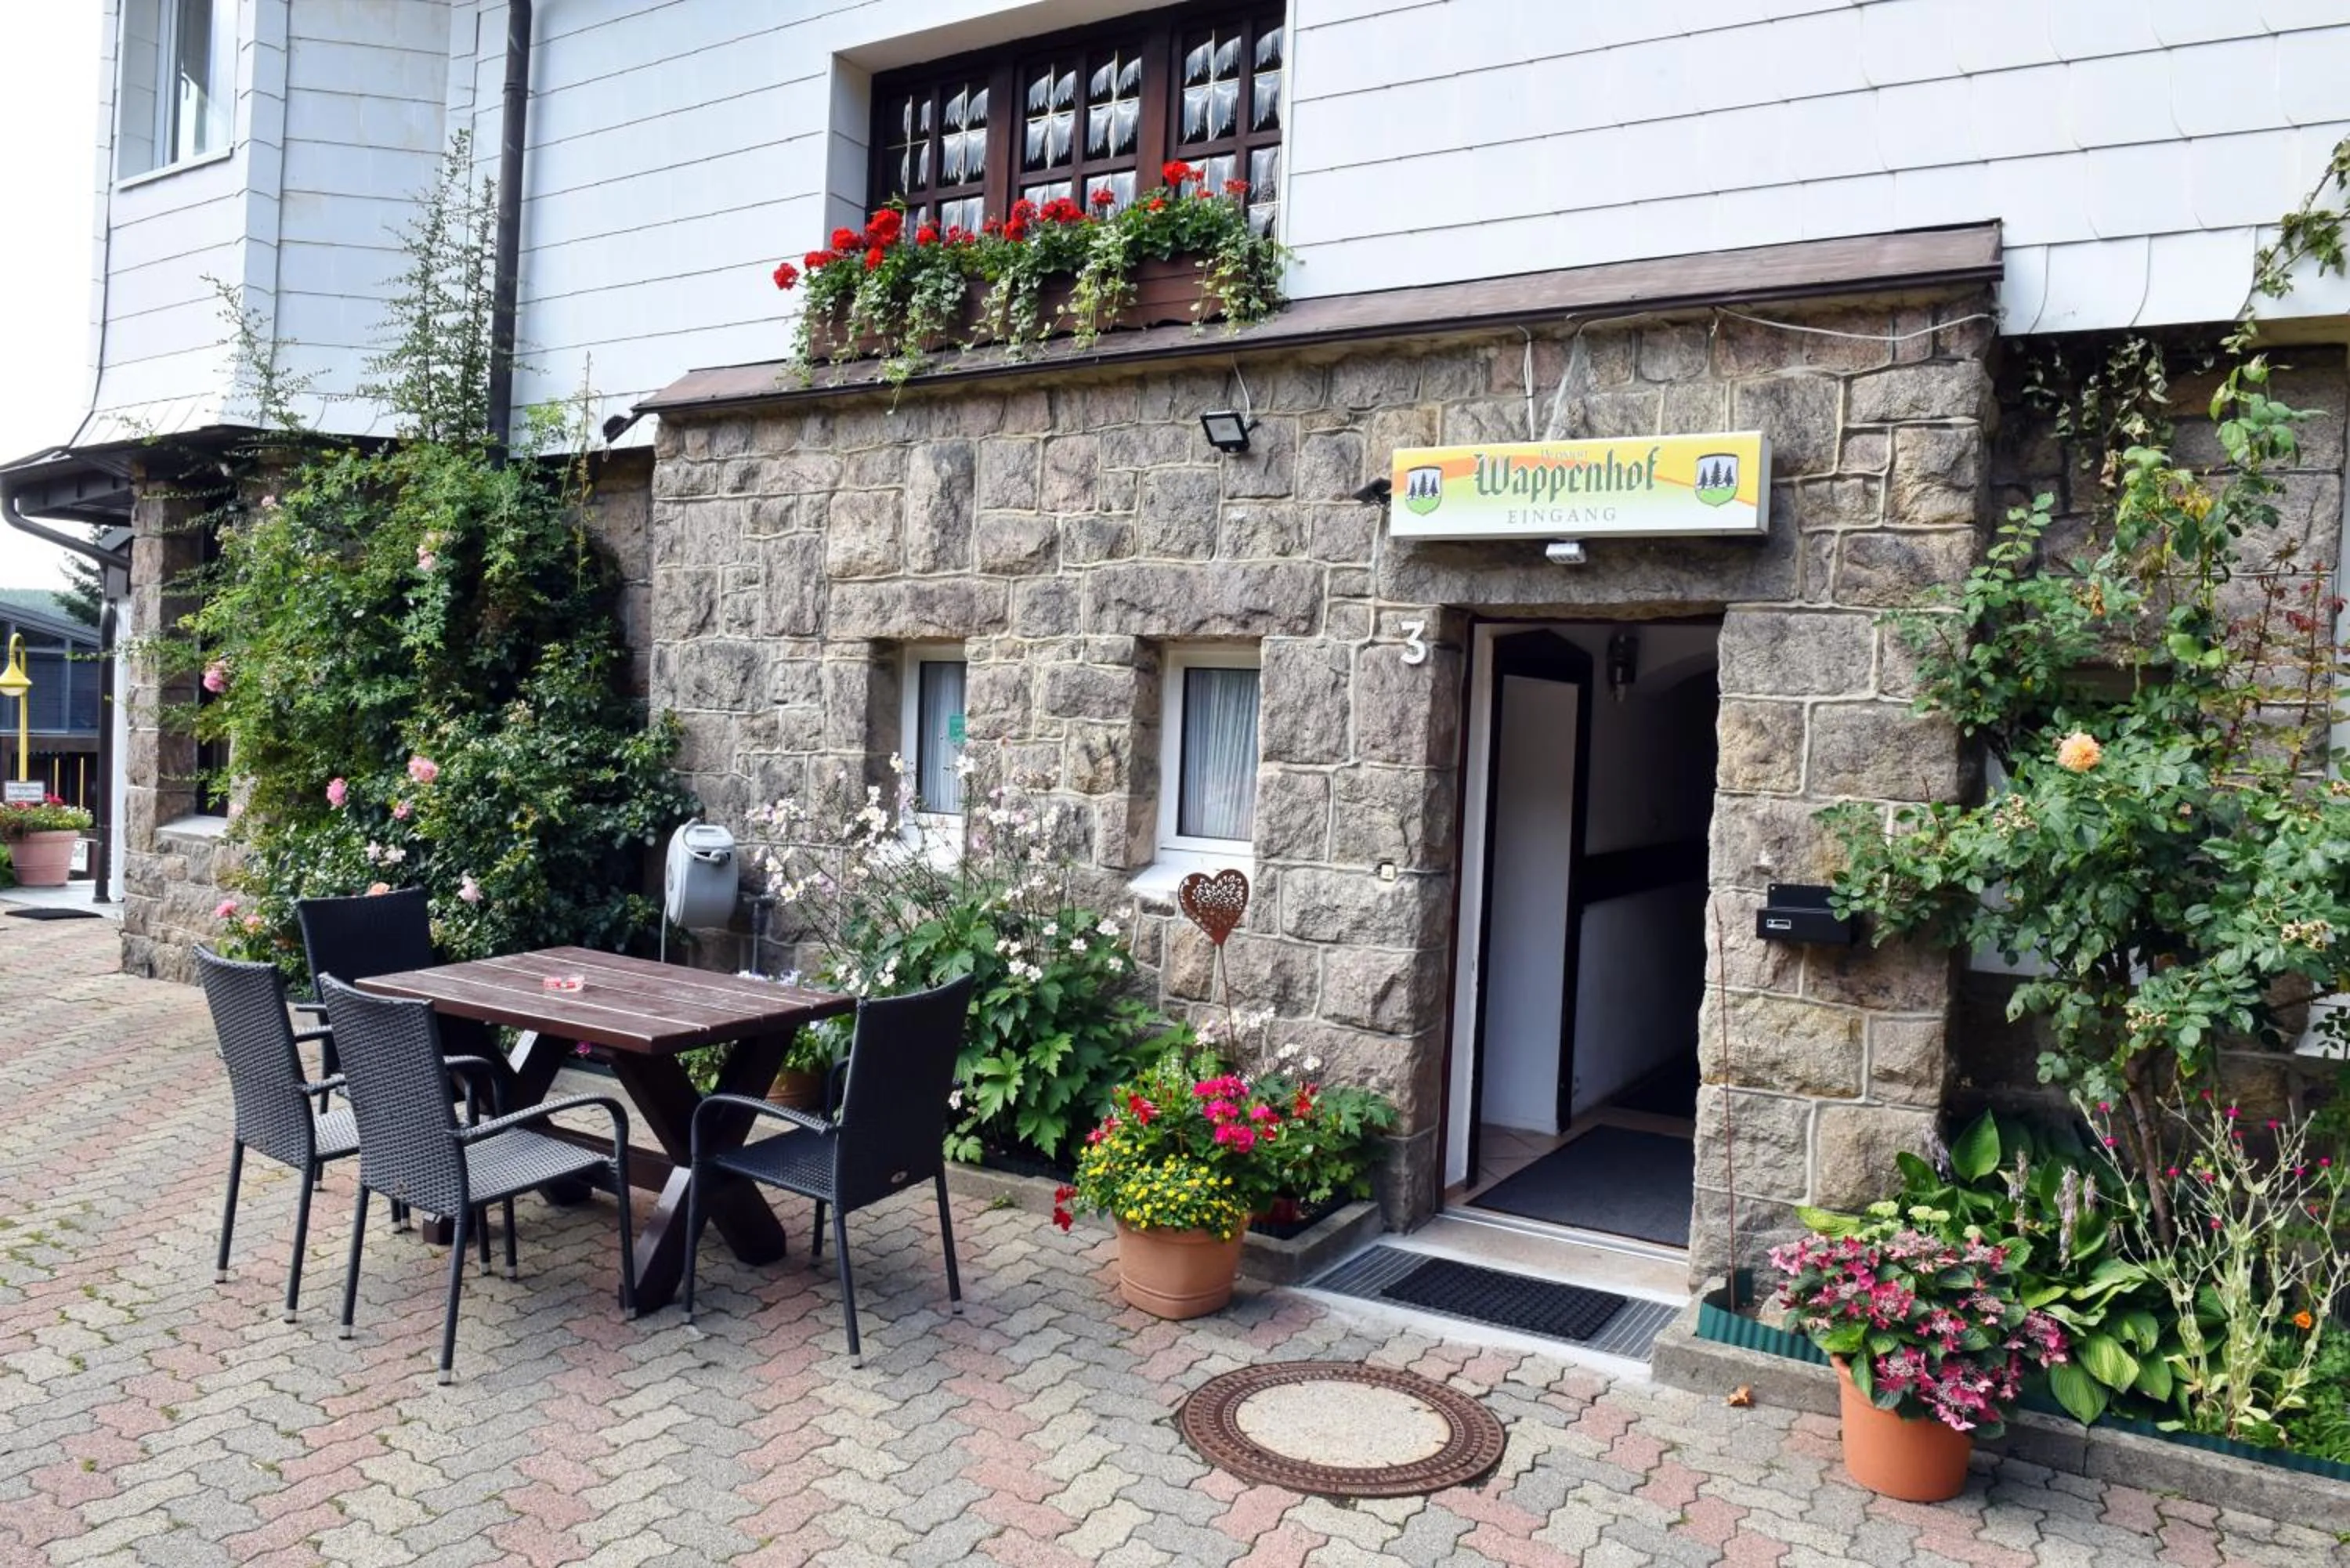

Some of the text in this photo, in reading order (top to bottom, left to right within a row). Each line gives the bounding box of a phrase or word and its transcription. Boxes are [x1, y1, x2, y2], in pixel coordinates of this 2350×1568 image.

[1474, 446, 1660, 503] Wappenhof
[1508, 507, 1616, 524] EINGANG
[1401, 620, 1426, 664] 3
